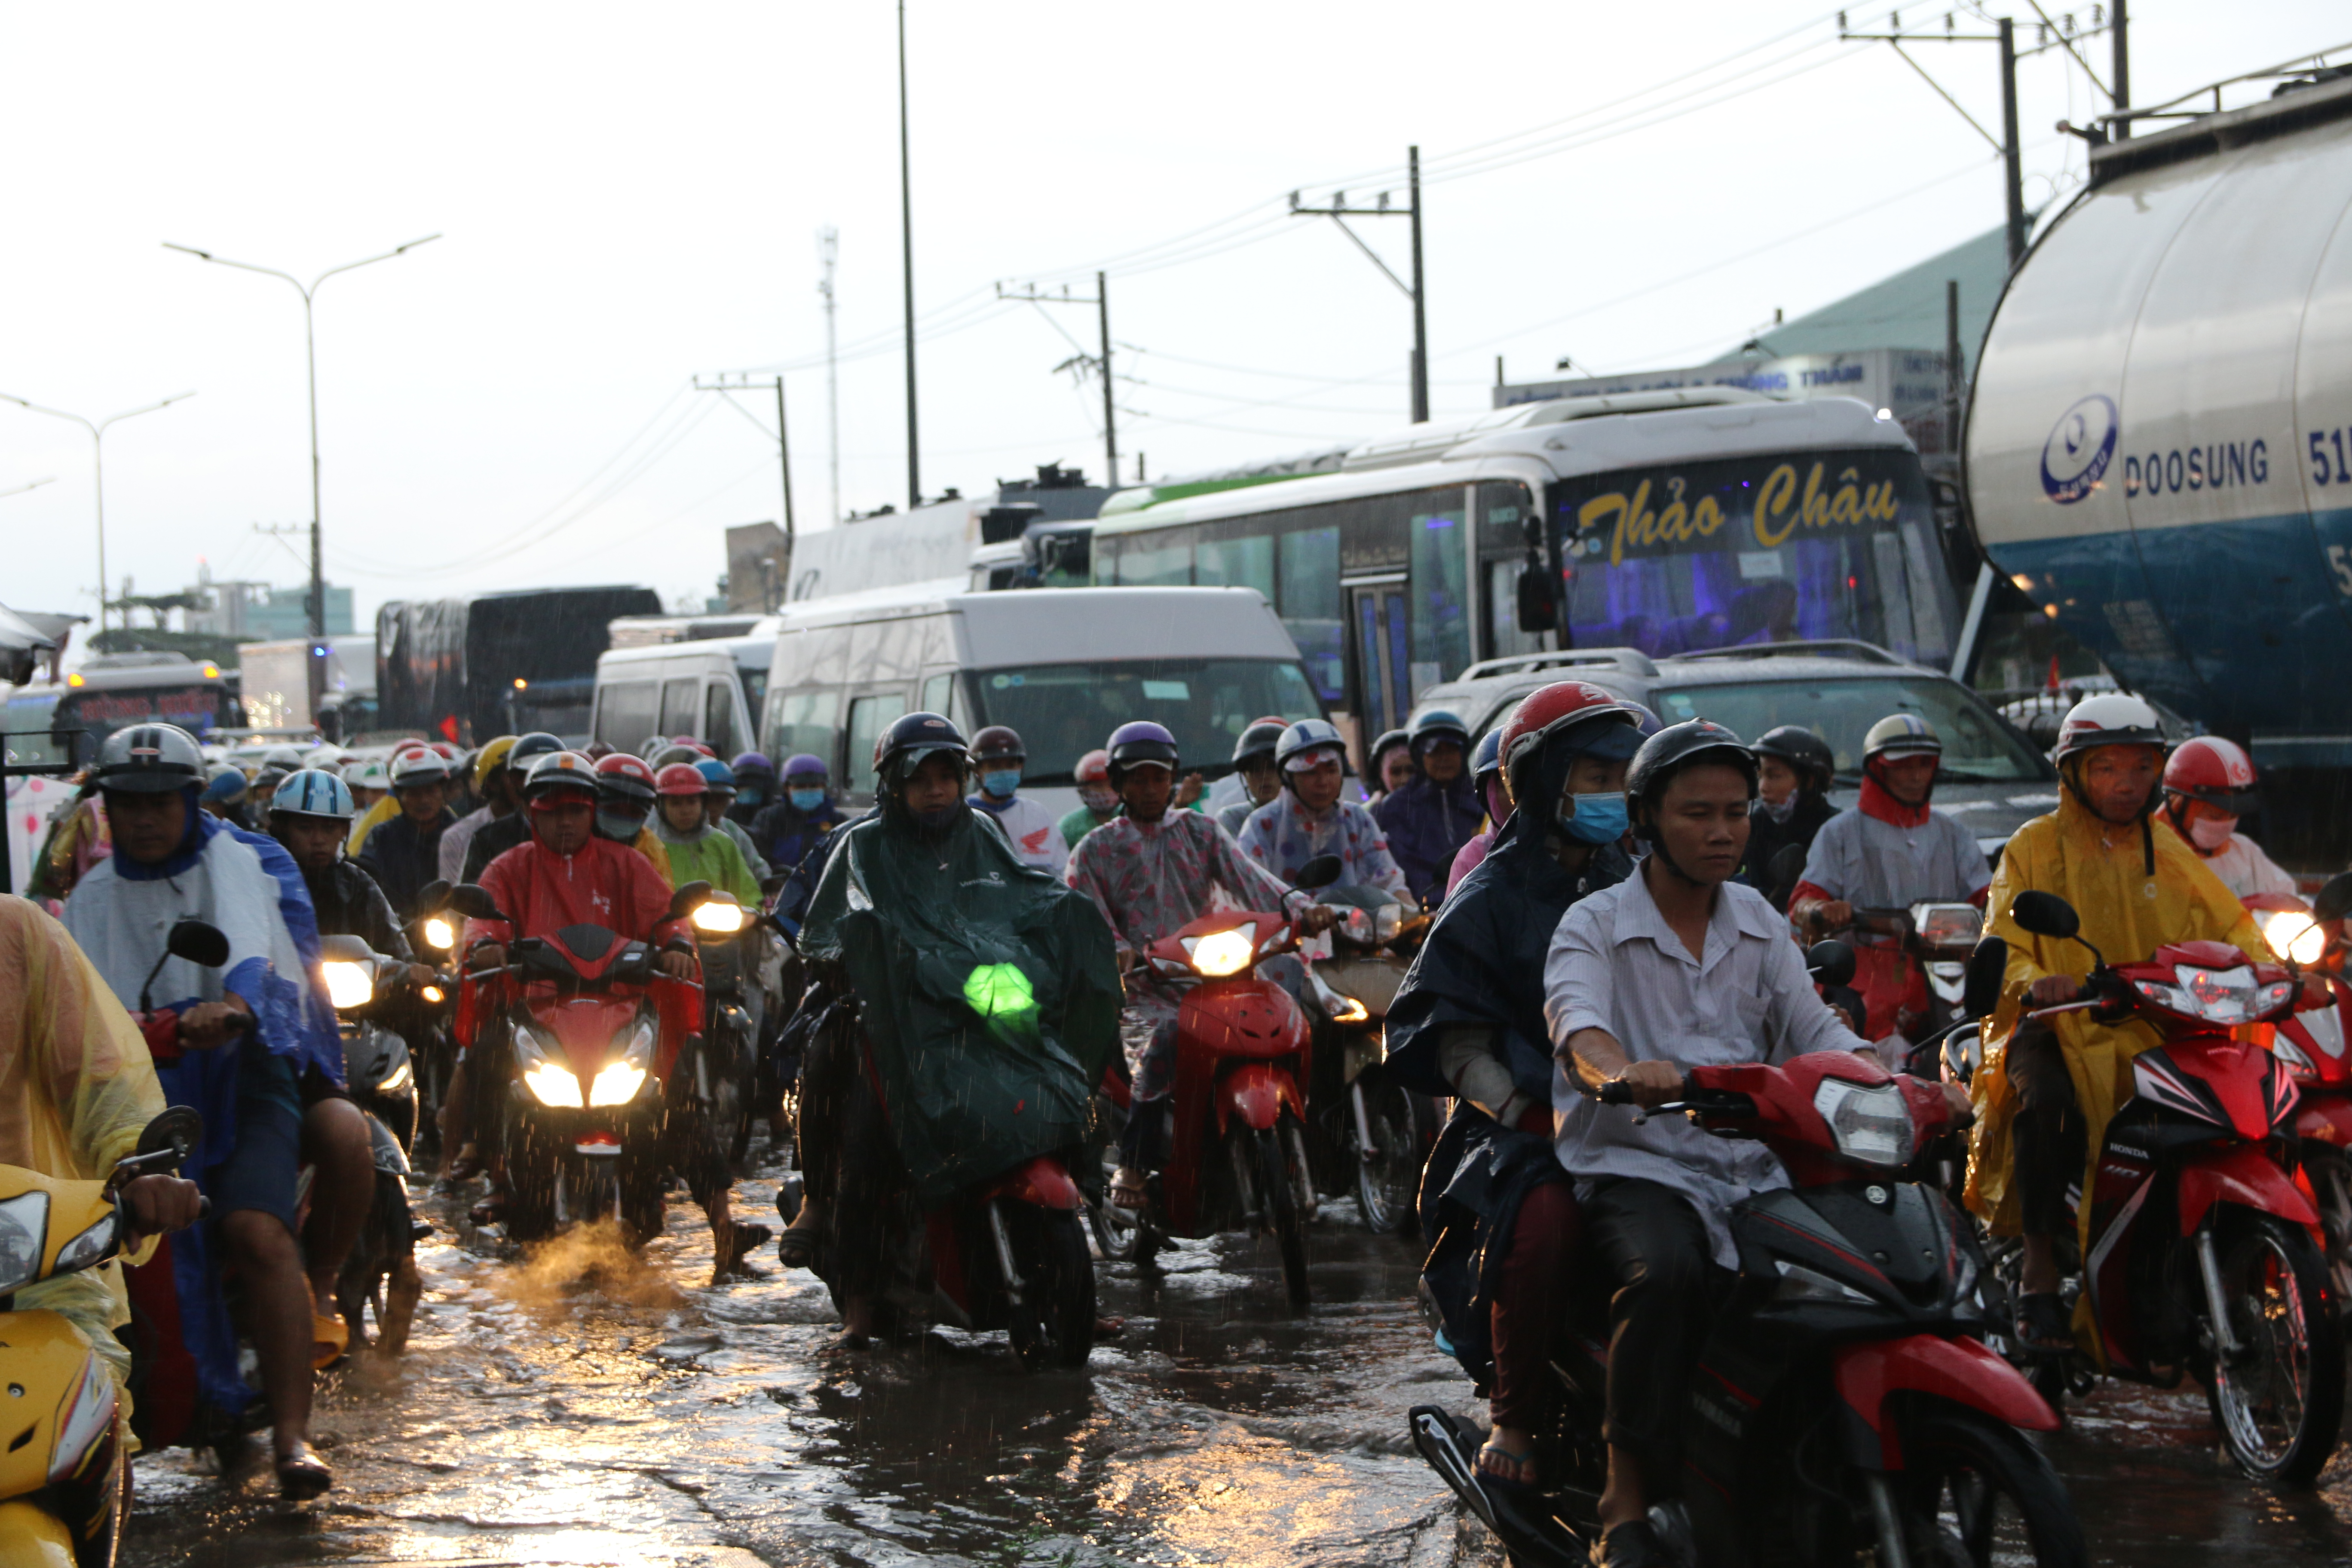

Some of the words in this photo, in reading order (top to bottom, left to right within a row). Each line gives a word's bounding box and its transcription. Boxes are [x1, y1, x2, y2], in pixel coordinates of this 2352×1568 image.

[2125, 439, 2269, 497] DOOSUNG
[2309, 426, 2352, 488] 51
[1578, 476, 1725, 567] Thảo
[1753, 462, 1898, 547] Châu
[2327, 545, 2352, 596] 5
[960, 879, 1006, 887] Vietcombank
[2110, 1143, 2149, 1159] HONDA
[1692, 1392, 1740, 1438] YAMAHA
